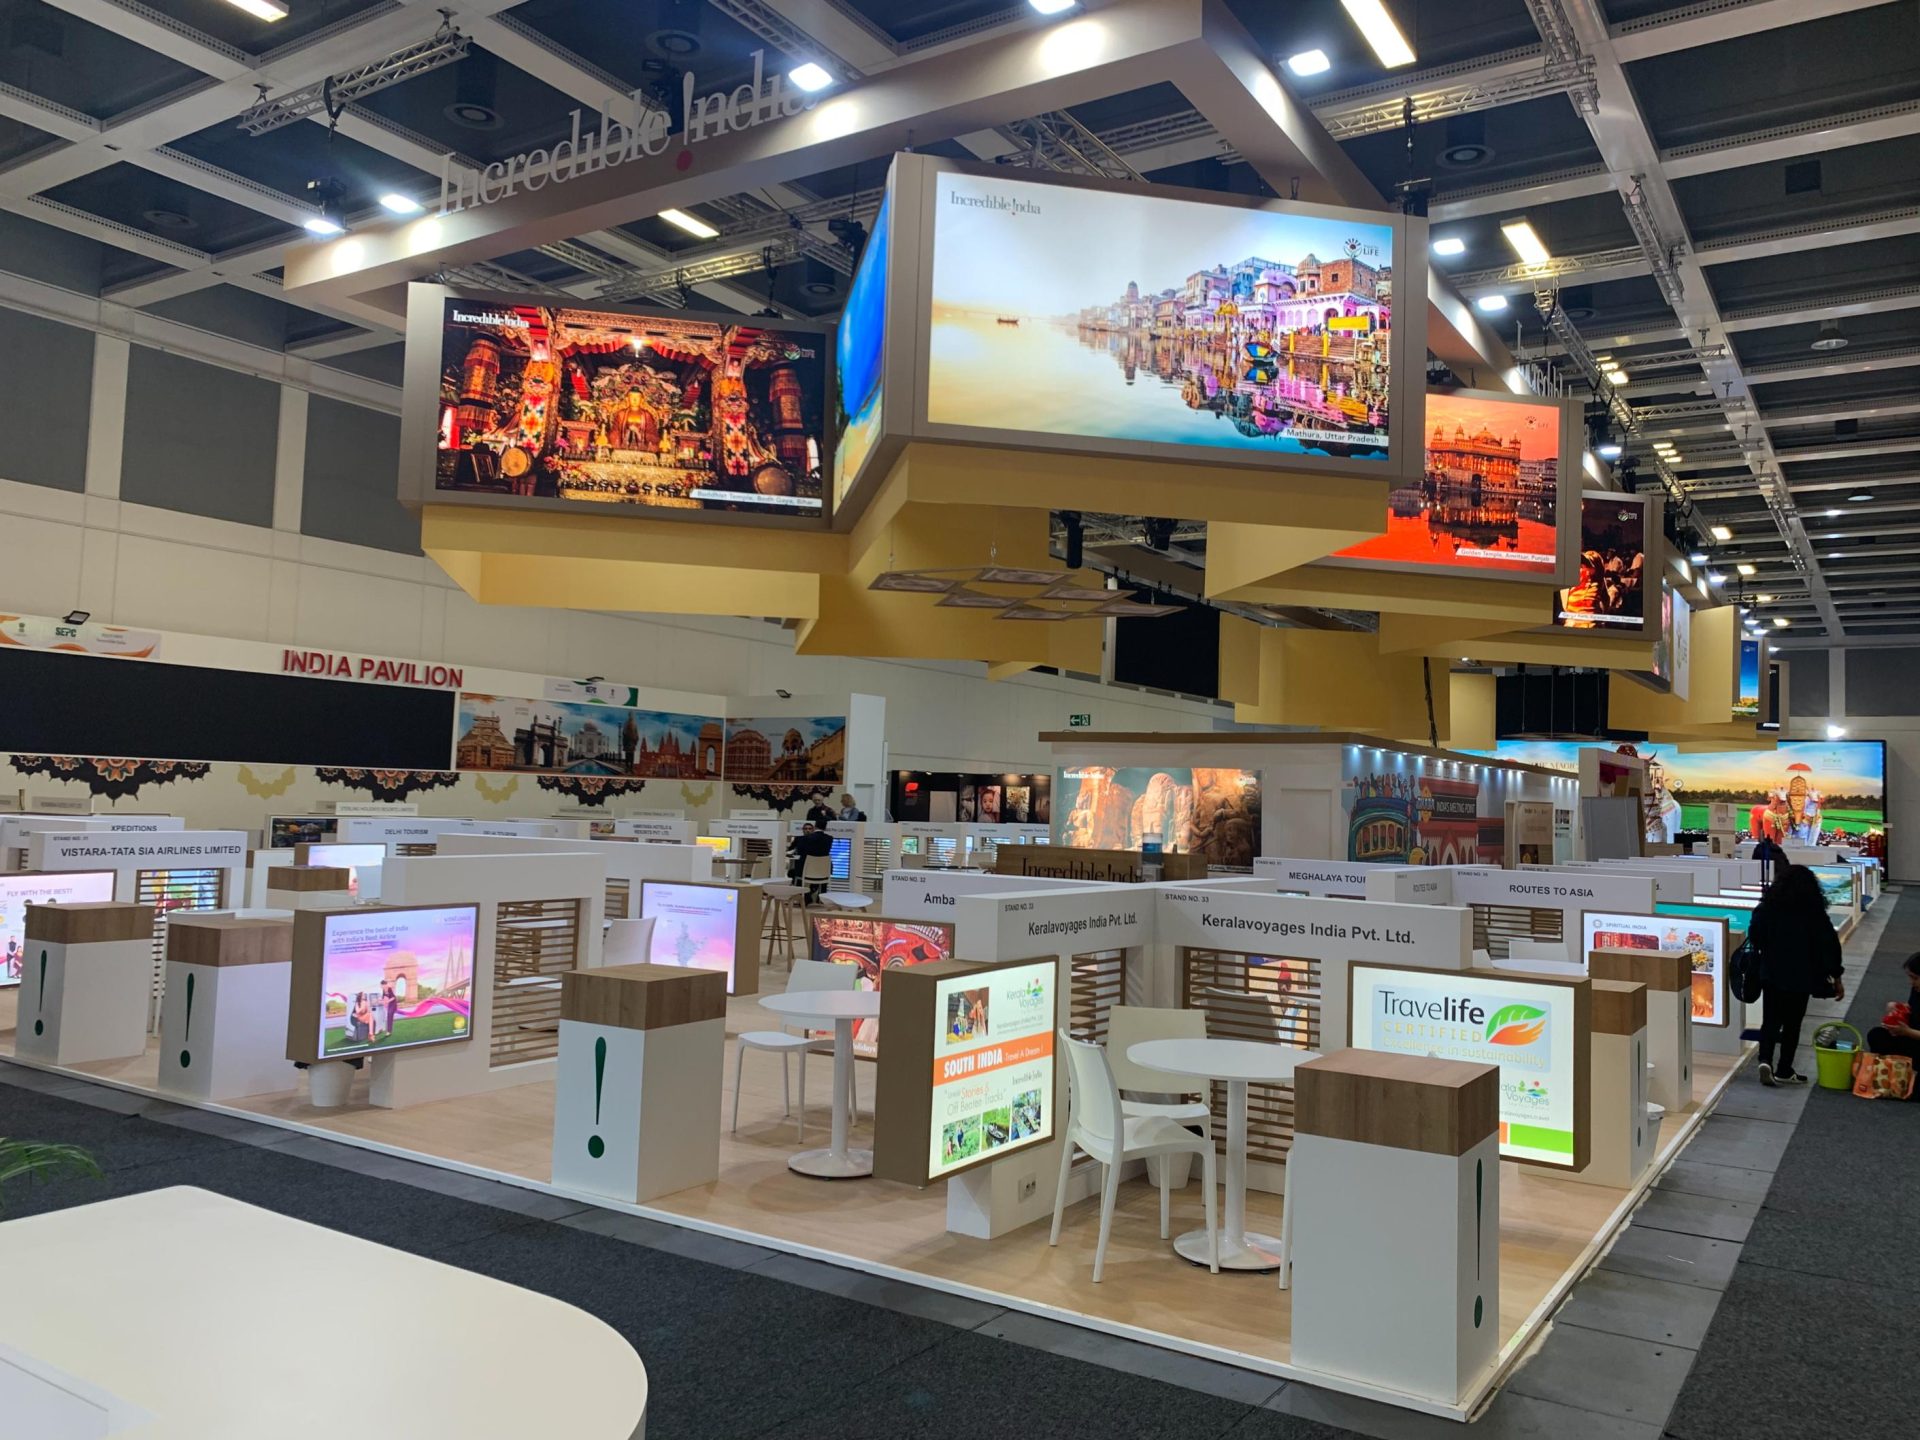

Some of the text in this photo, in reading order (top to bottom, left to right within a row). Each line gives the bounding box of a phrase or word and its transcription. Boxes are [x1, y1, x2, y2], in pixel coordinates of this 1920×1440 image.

[436, 87, 673, 218] Incredible
[951, 190, 1011, 210] Incredible
[453, 309, 504, 325] Incredible
[1286, 429, 1380, 444] Mathura, Uttar Pradesh
[283, 649, 463, 688] INDIA PAVILION
[61, 845, 241, 857] VISTARA-TATA SIA AIRLINES LIMITED
[1289, 872, 1343, 882] MEGHALAYA
[20, 889, 38, 897] WITH
[924, 892, 956, 905] Amba
[1509, 884, 1594, 897] ROUTES TO ASIA
[332, 928, 364, 937] Experience
[365, 927, 374, 935] the
[1028, 912, 1138, 936] Keralavoyages India Pvt. Ltd.
[1202, 914, 1415, 945] Keralavoyages India Pvt. Ltd.
[1606, 922, 1631, 930] SPIRITUAL
[1378, 990, 1485, 1025] Travelife
[1382, 1021, 1482, 1043] CERTIFIED
[1383, 1037, 1546, 1069] Excellence in sustainability
[944, 1055, 975, 1079] SOUTH
[977, 1048, 1003, 1070] INDIA
[1506, 1092, 1550, 1106] Voyages
